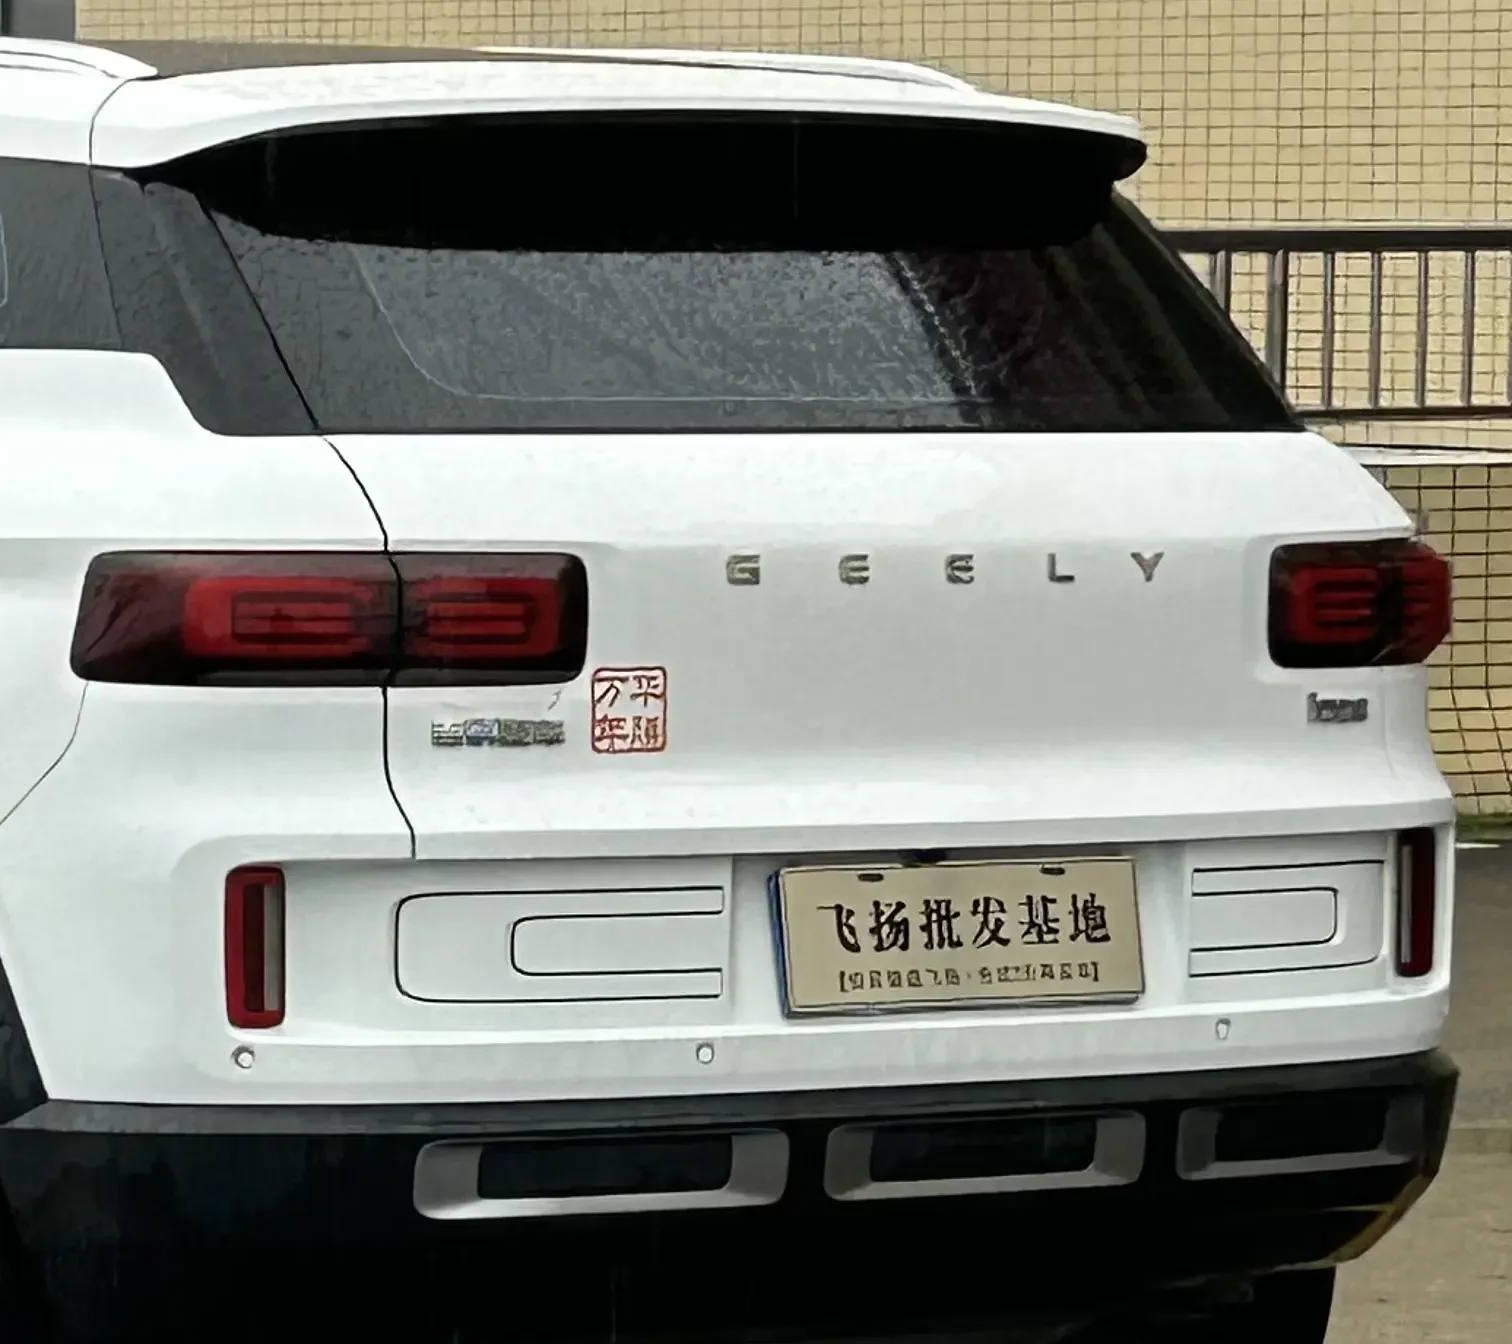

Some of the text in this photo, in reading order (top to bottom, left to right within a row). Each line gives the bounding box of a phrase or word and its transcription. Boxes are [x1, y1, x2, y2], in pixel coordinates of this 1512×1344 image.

[725, 552, 1165, 586] GEELY
[817, 893, 1110, 953] 飞扬批发基地
